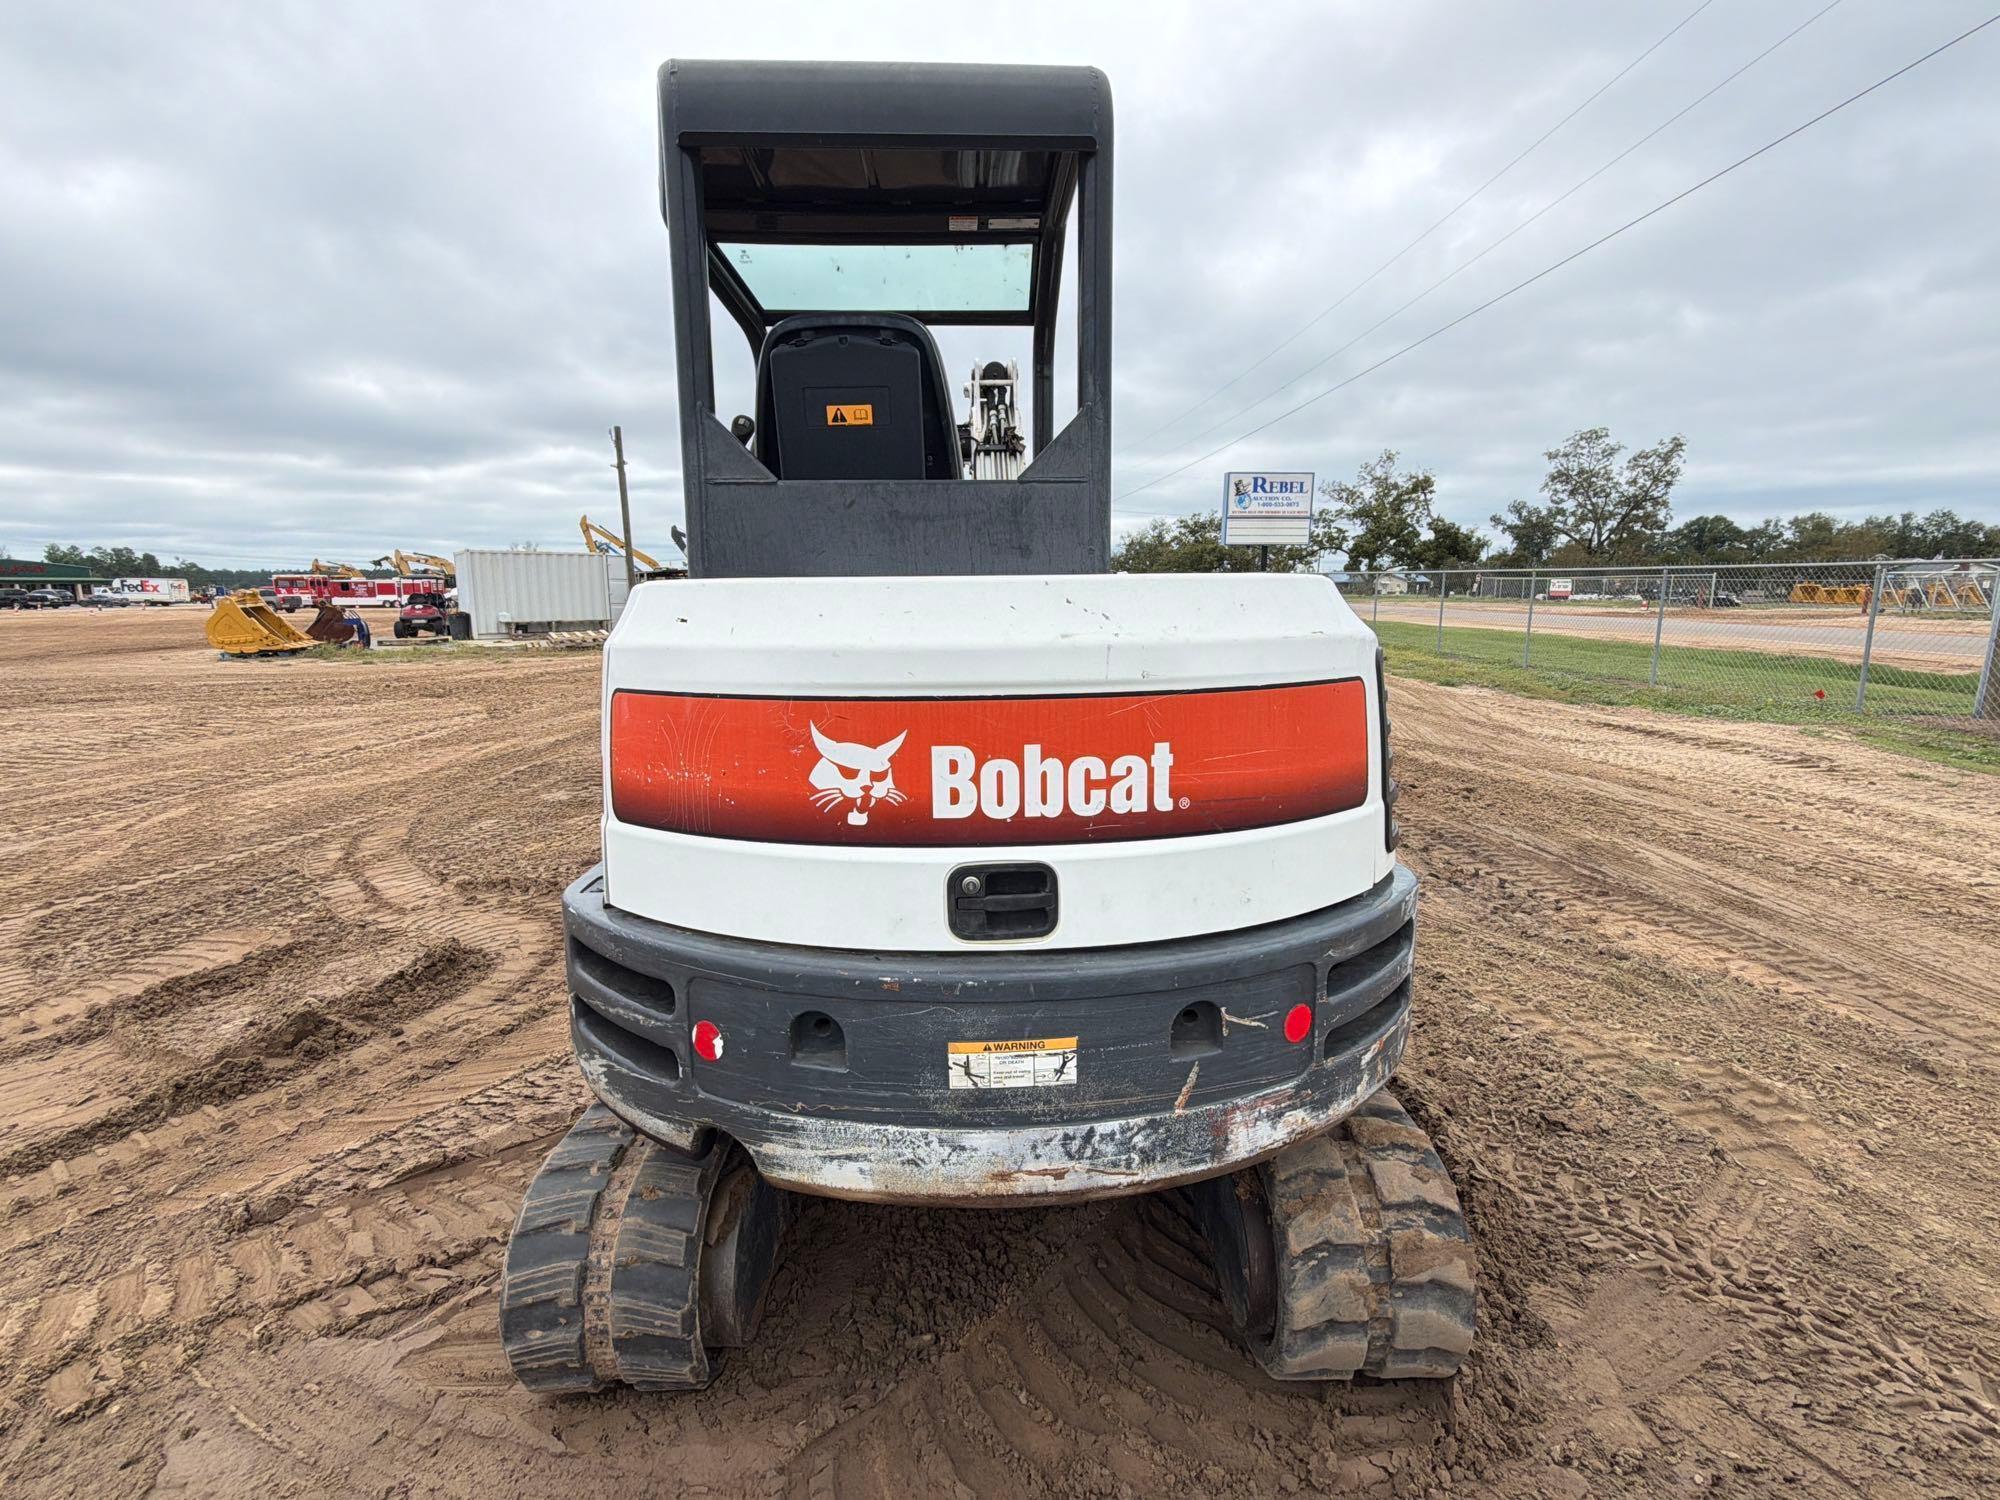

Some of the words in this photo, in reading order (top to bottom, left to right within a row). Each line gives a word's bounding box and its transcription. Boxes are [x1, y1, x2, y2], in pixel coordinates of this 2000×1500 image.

[1252, 476, 1308, 494] REBEL
[120, 580, 160, 593] FedEx
[931, 741, 1174, 820] Bobcat
[993, 1040, 1046, 1051] WARNING
